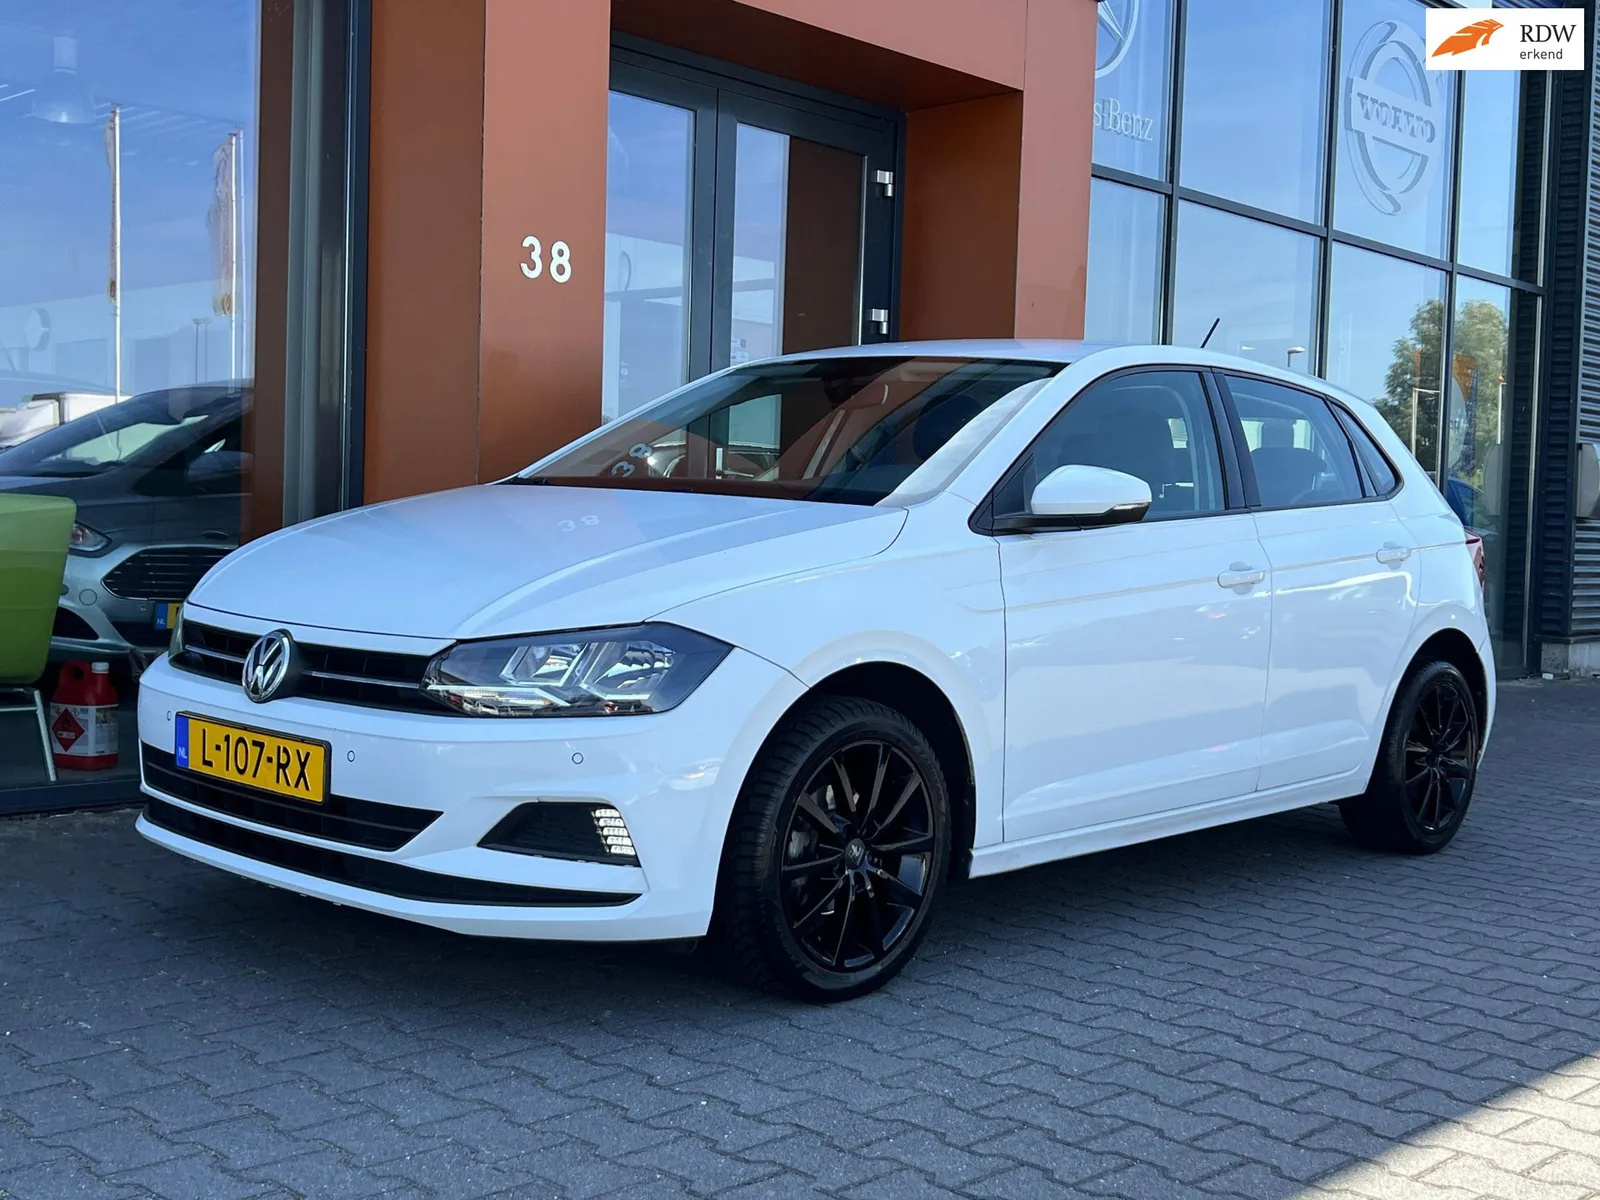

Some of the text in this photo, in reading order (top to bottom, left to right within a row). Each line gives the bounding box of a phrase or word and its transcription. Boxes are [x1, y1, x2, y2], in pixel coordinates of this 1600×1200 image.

[1356, 92, 1436, 143] VOLVO
[520, 235, 572, 283] 38
[178, 746, 188, 759] NL
[202, 728, 311, 792] L-107-RX
